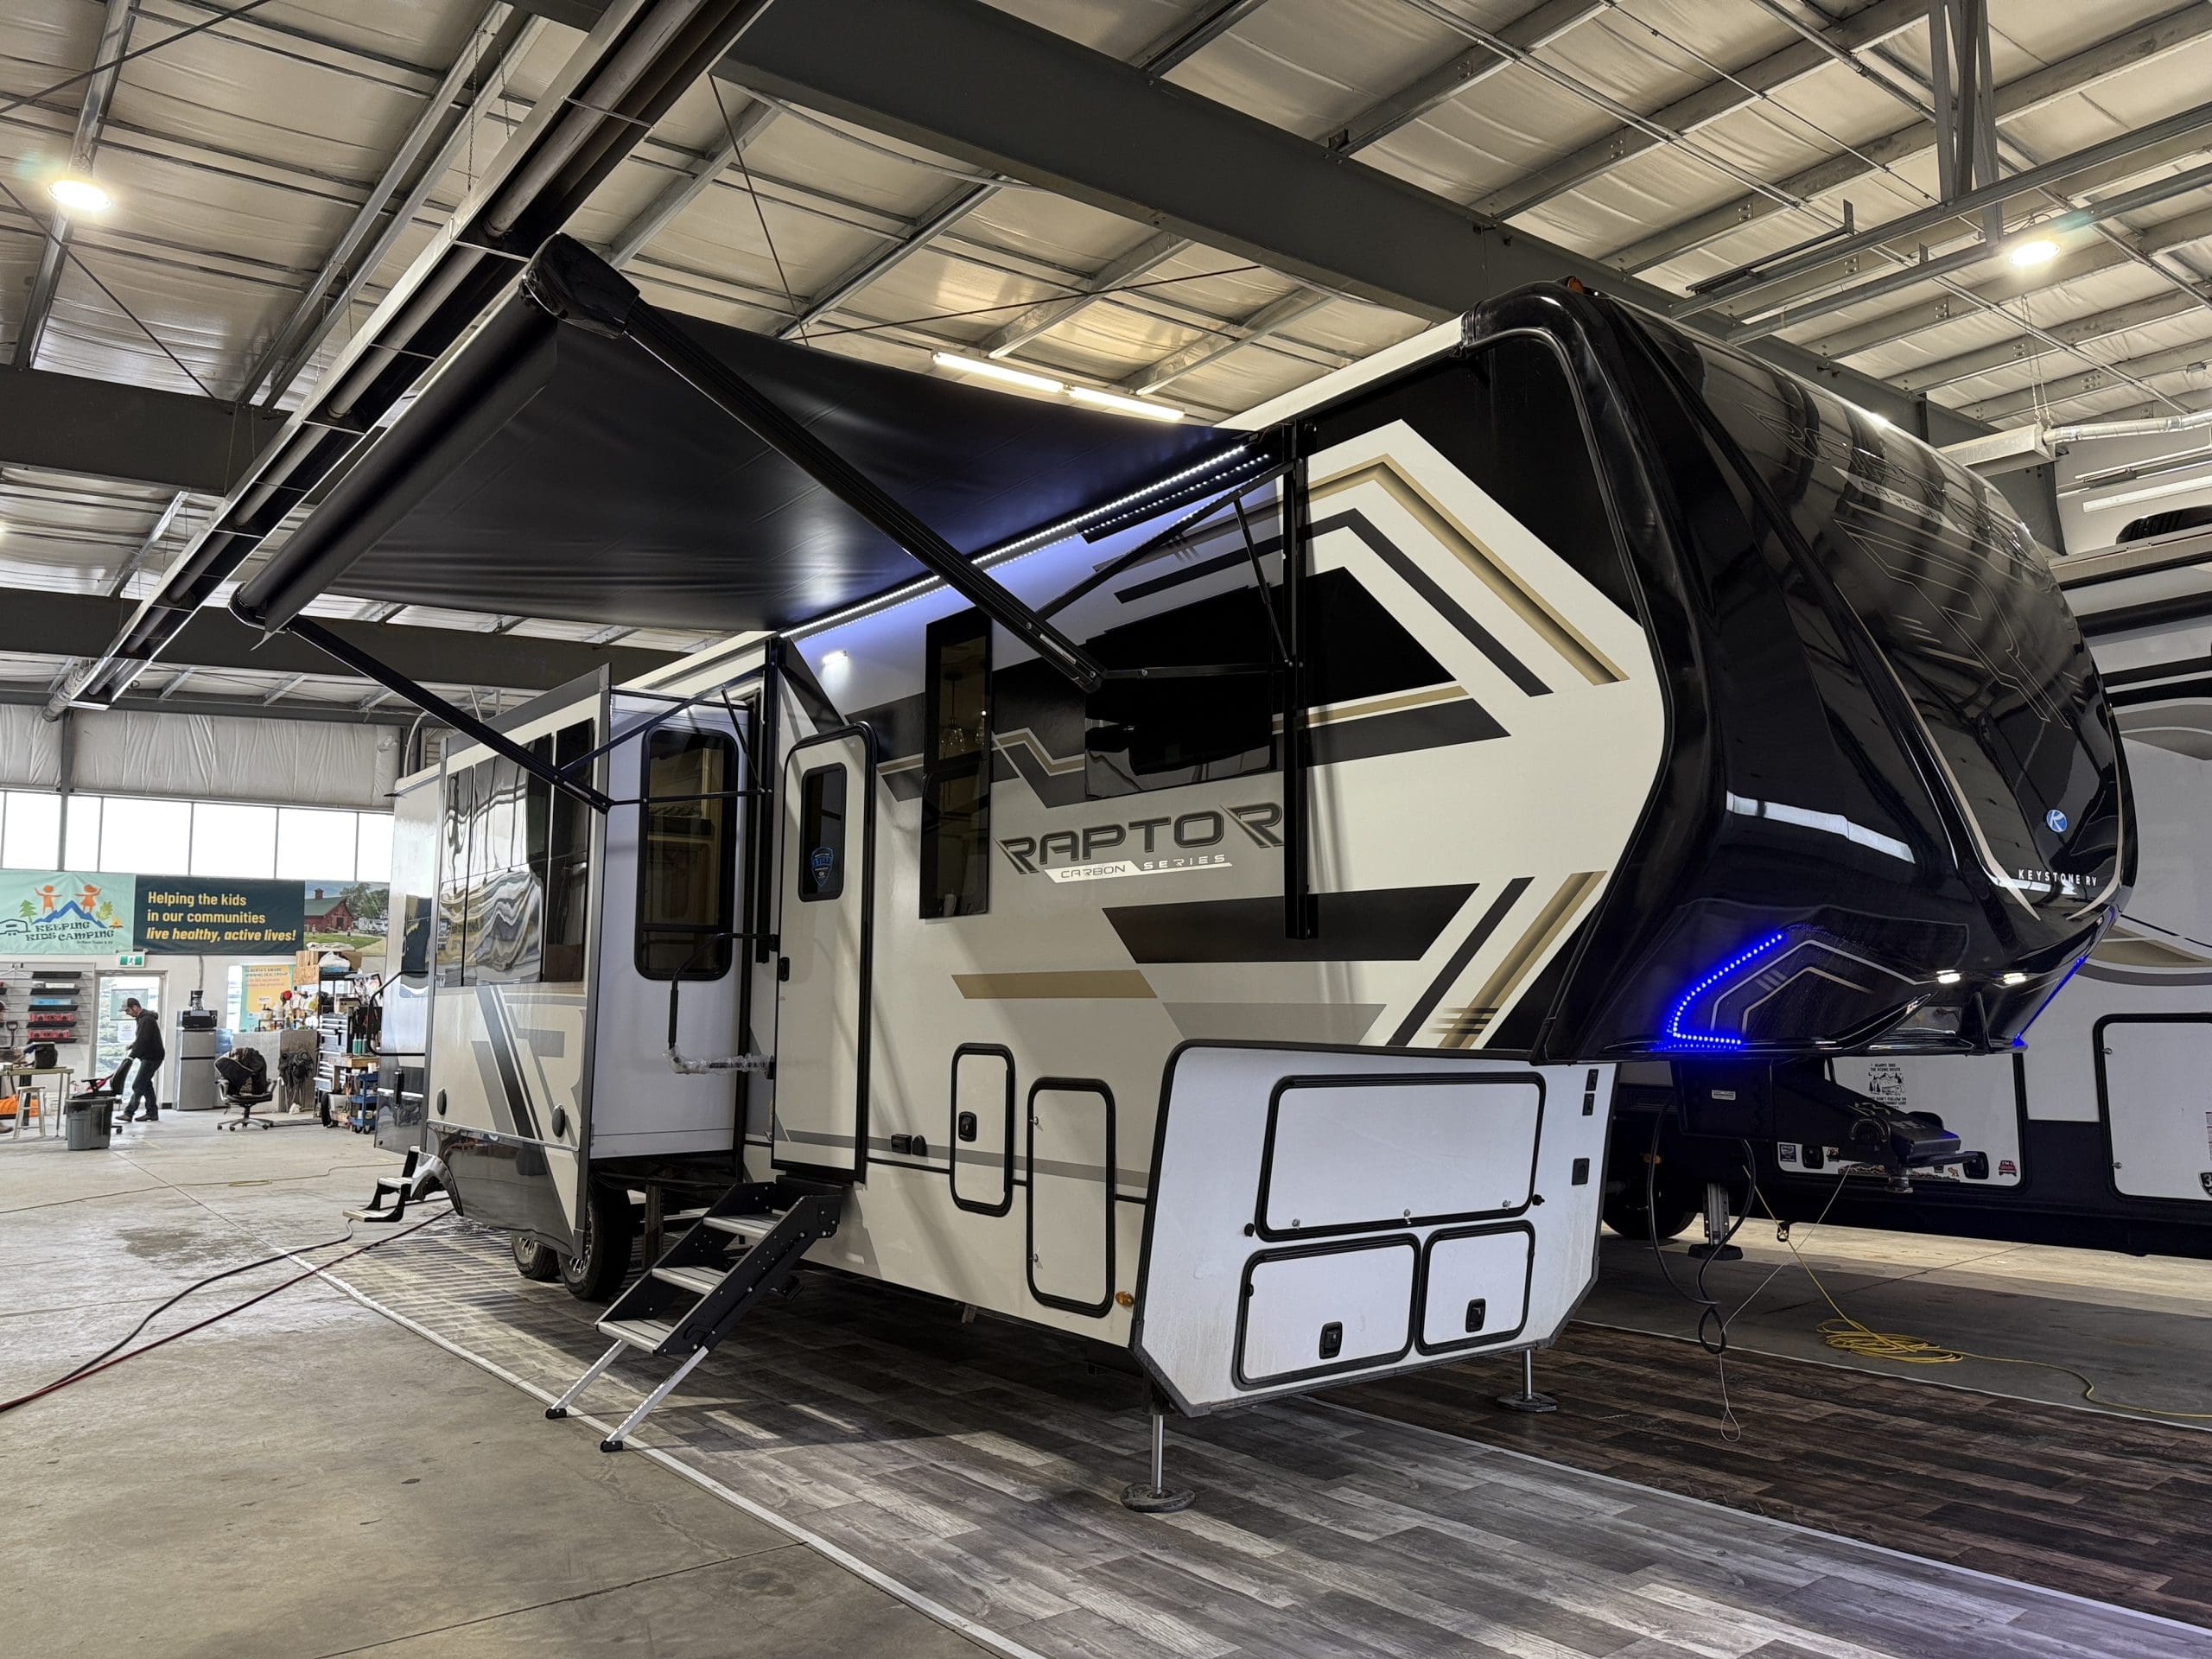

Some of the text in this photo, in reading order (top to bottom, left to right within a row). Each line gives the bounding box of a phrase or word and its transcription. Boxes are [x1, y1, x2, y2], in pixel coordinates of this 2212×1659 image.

[1861, 479, 1943, 522] CARBON
[994, 802, 1285, 874] RAPTOR
[1060, 854, 1226, 879] CARBON SERIES
[2018, 869, 2097, 887] KEYSTONE RV
[148, 892, 247, 907] Helping the kids
[147, 909, 266, 924] in our communities
[35, 921, 90, 932] KEEPING
[25, 929, 114, 942] KIDS CAMPING
[146, 927, 296, 943] live healthy, active lives!
